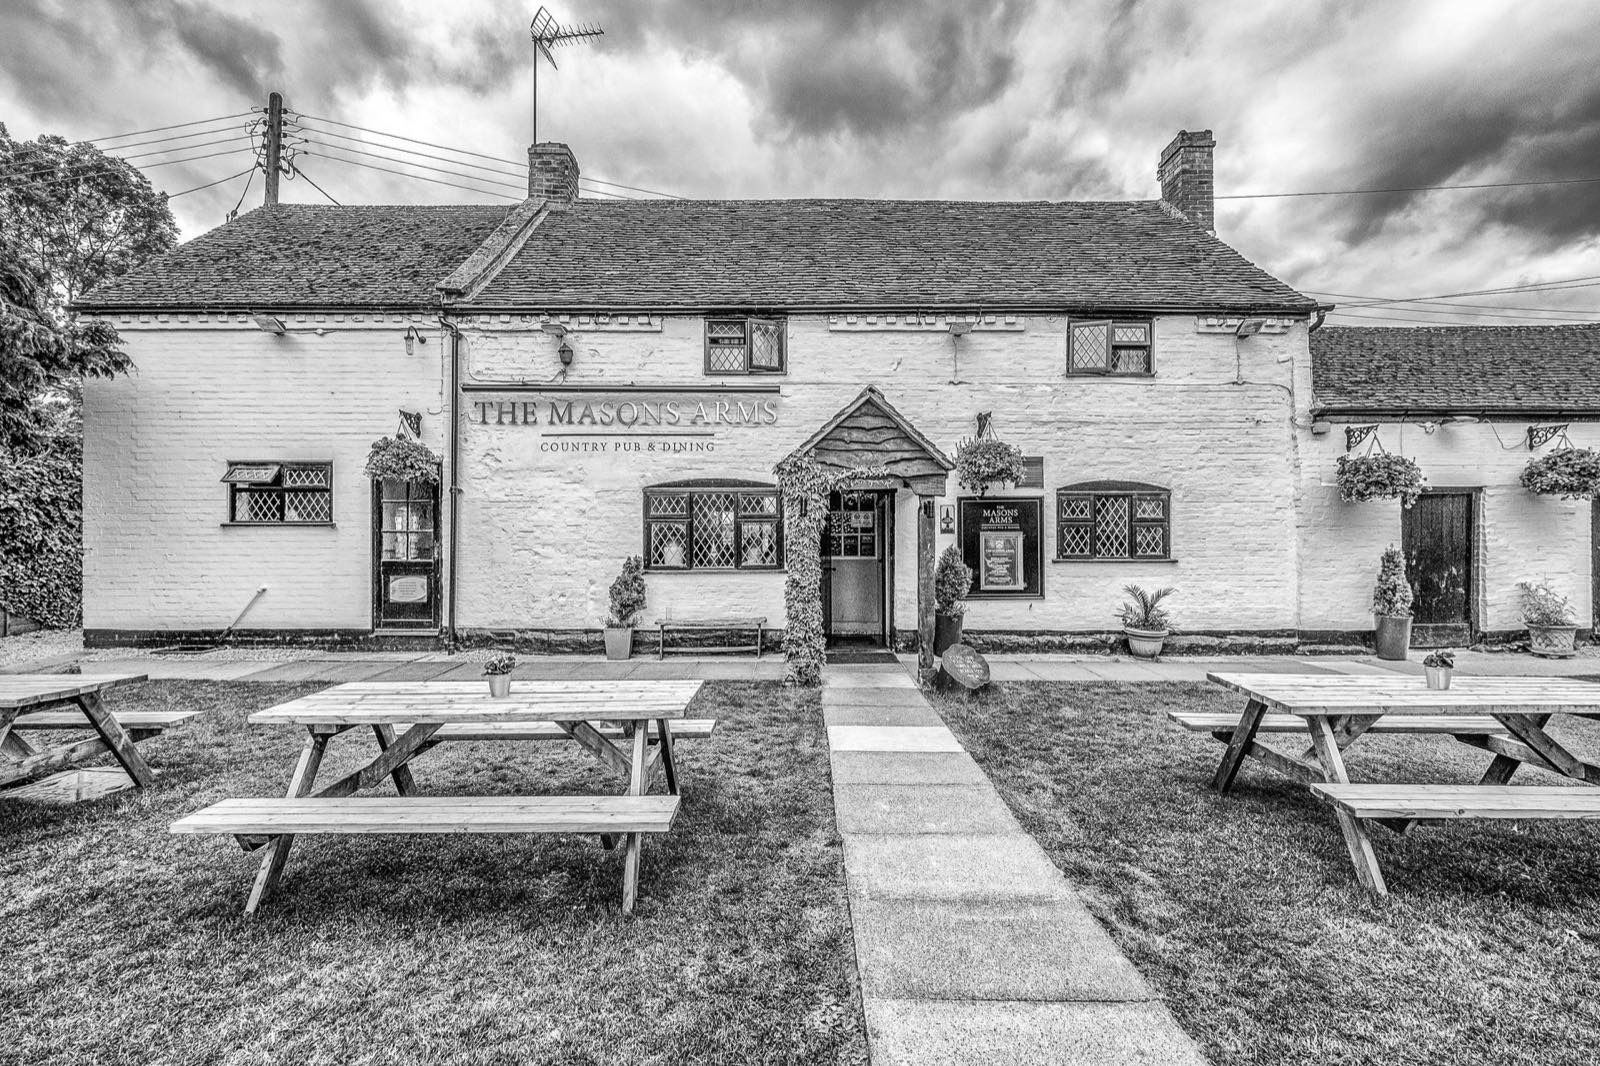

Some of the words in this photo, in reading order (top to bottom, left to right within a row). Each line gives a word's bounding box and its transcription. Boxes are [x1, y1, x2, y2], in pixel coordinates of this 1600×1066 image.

[474, 401, 538, 426] THE
[548, 400, 680, 429] MASONS
[690, 400, 778, 426] ARMS
[540, 441, 608, 453] COUNTRY
[614, 441, 641, 452] PUB
[647, 441, 656, 452] &
[662, 441, 716, 453] DINING
[982, 508, 1019, 517] MASONS
[988, 516, 1013, 524] ARMS
